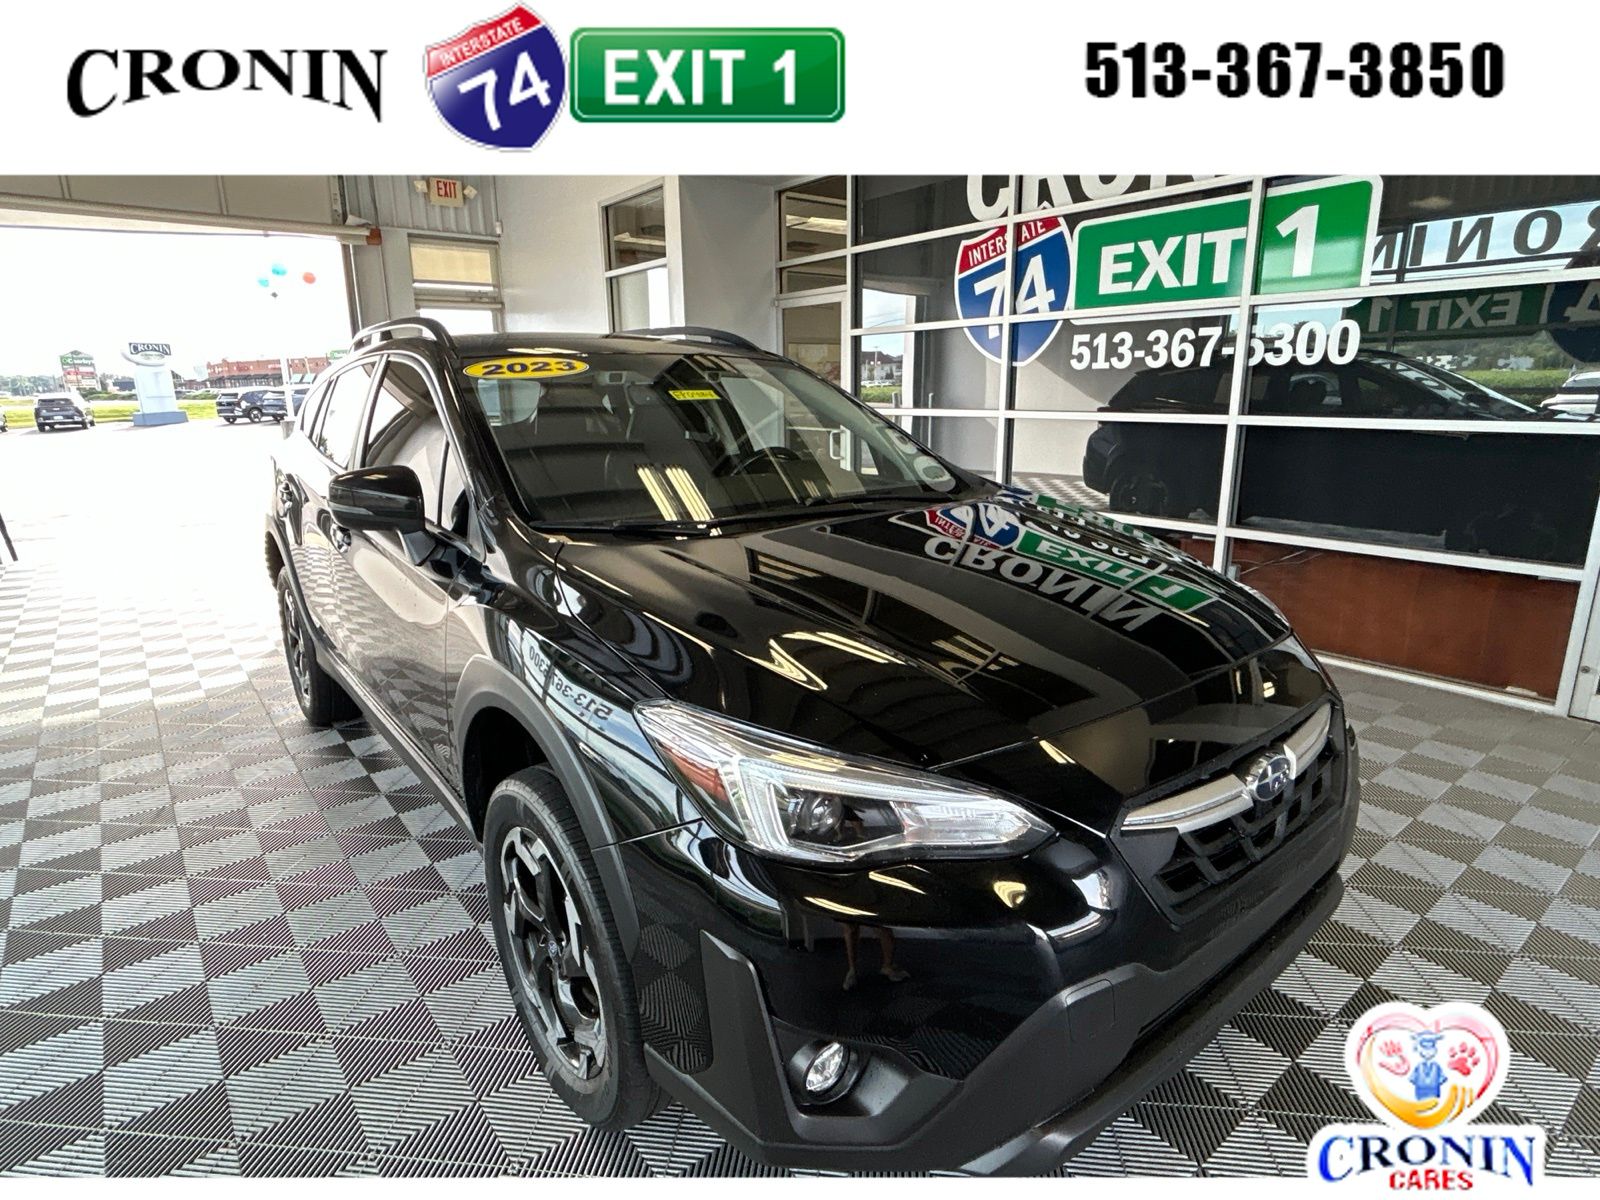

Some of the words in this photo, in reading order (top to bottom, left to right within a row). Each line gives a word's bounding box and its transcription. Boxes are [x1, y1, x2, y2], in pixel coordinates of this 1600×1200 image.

[436, 180, 457, 198] EXIT
[968, 220, 1046, 267] INTERATE
[1099, 226, 1247, 295] EXIT
[1276, 204, 1320, 278] 1
[974, 254, 1056, 340] 74
[130, 343, 171, 355] CRONIN
[482, 361, 576, 375] 2023
